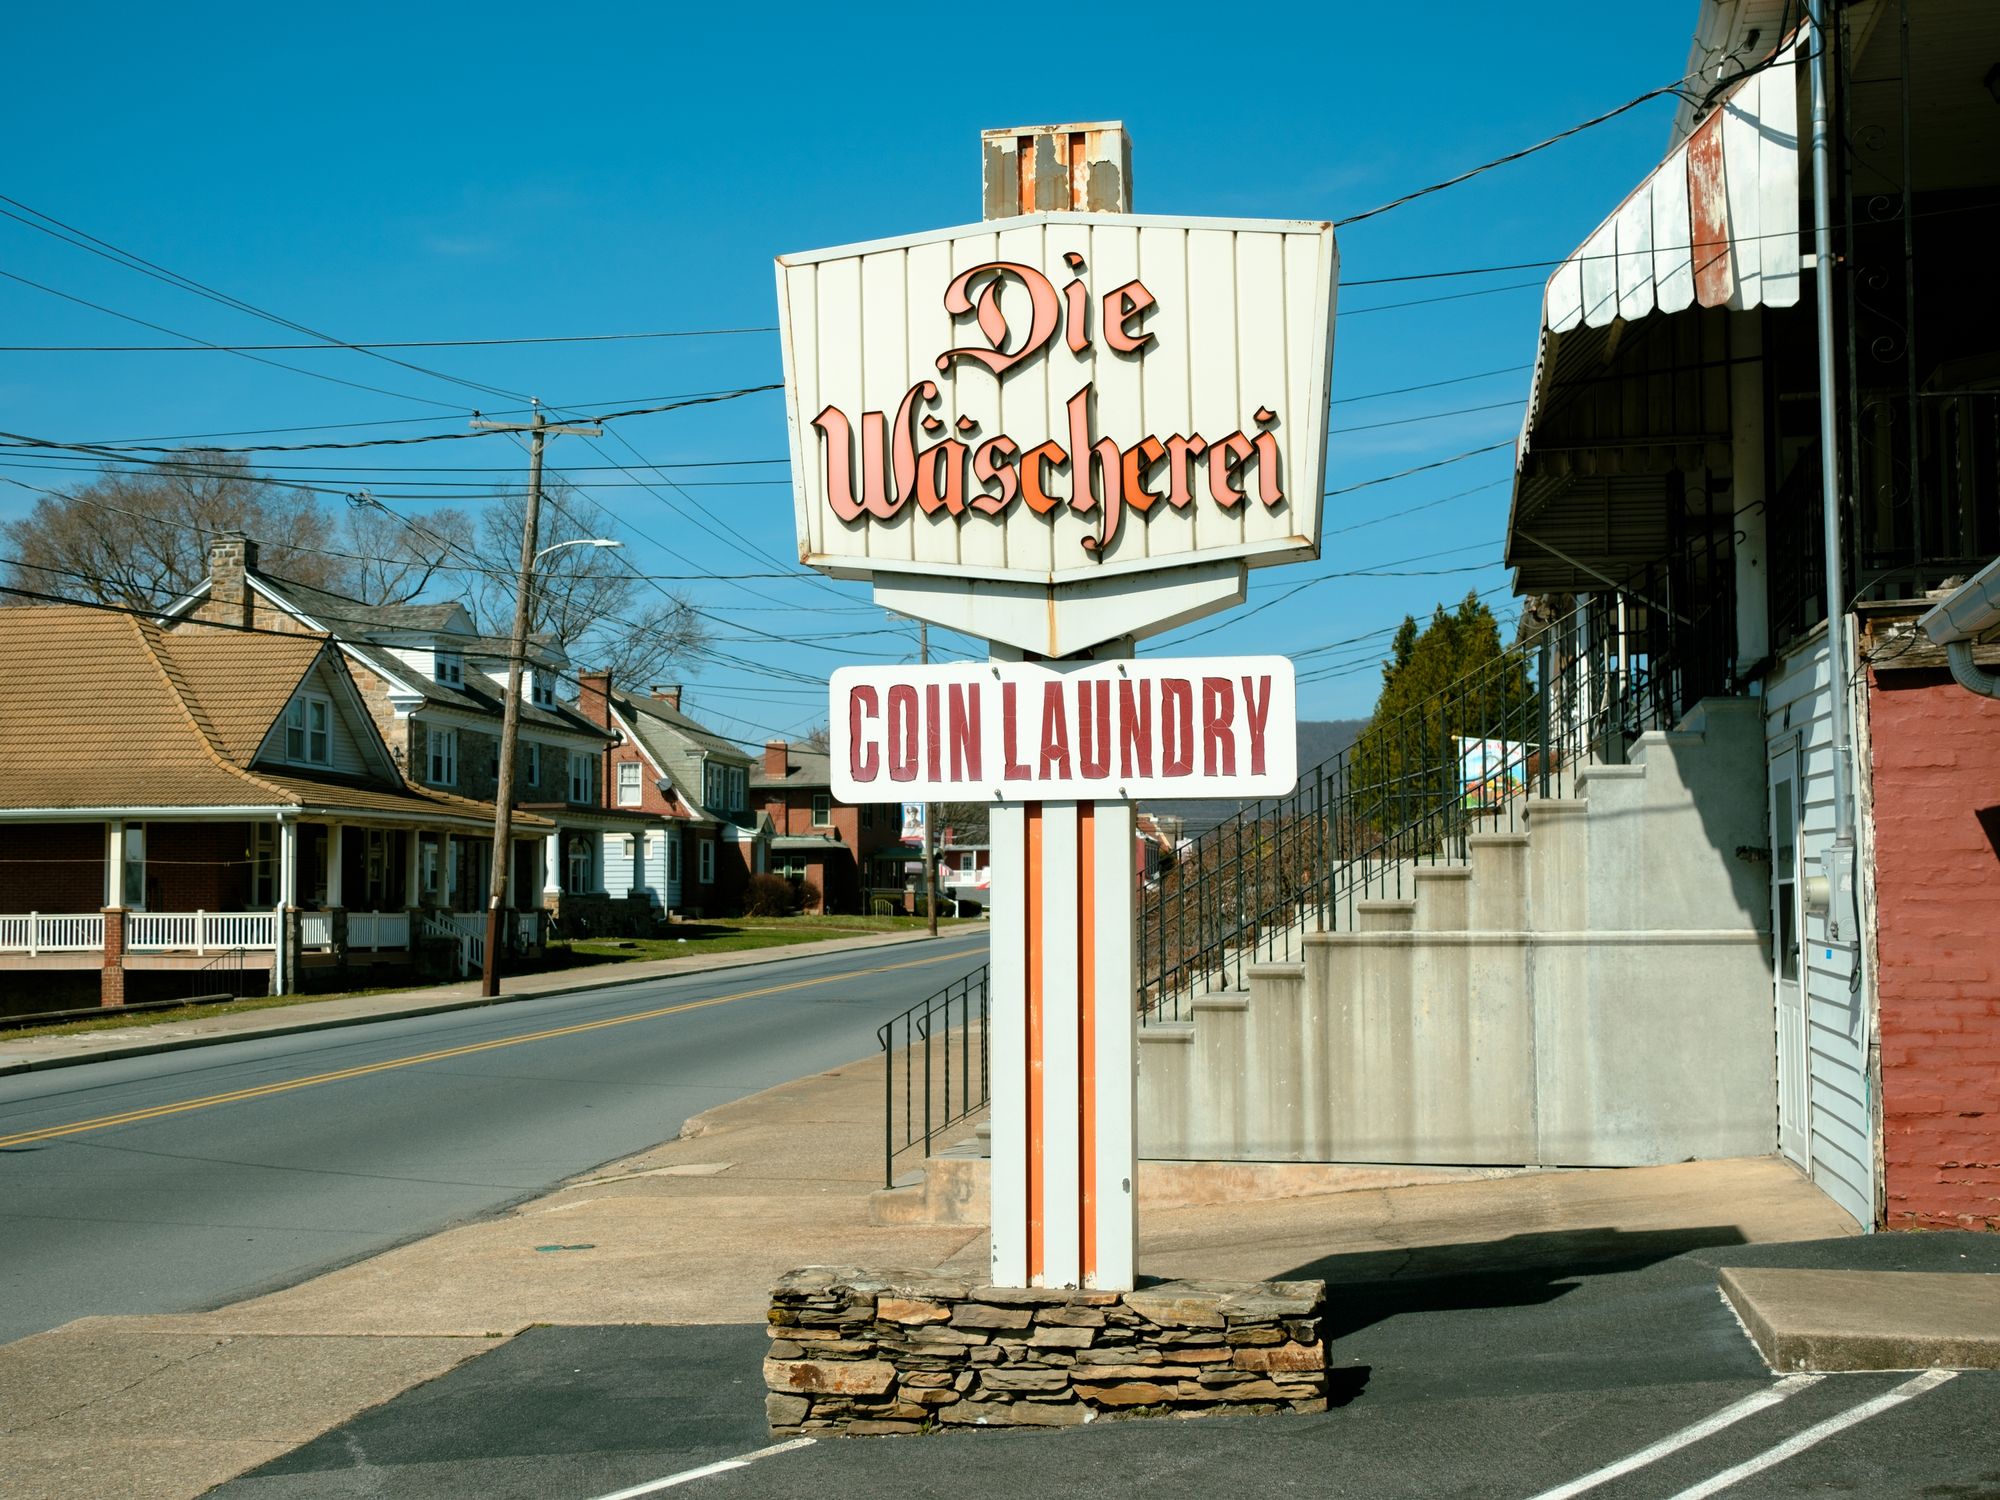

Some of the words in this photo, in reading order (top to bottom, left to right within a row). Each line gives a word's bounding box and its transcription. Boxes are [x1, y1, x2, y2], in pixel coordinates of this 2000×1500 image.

[935, 252, 1157, 375] Die
[811, 381, 1284, 552] Wäscherei
[849, 683, 983, 782] COIN
[1002, 675, 1272, 781] LAUNDRY
